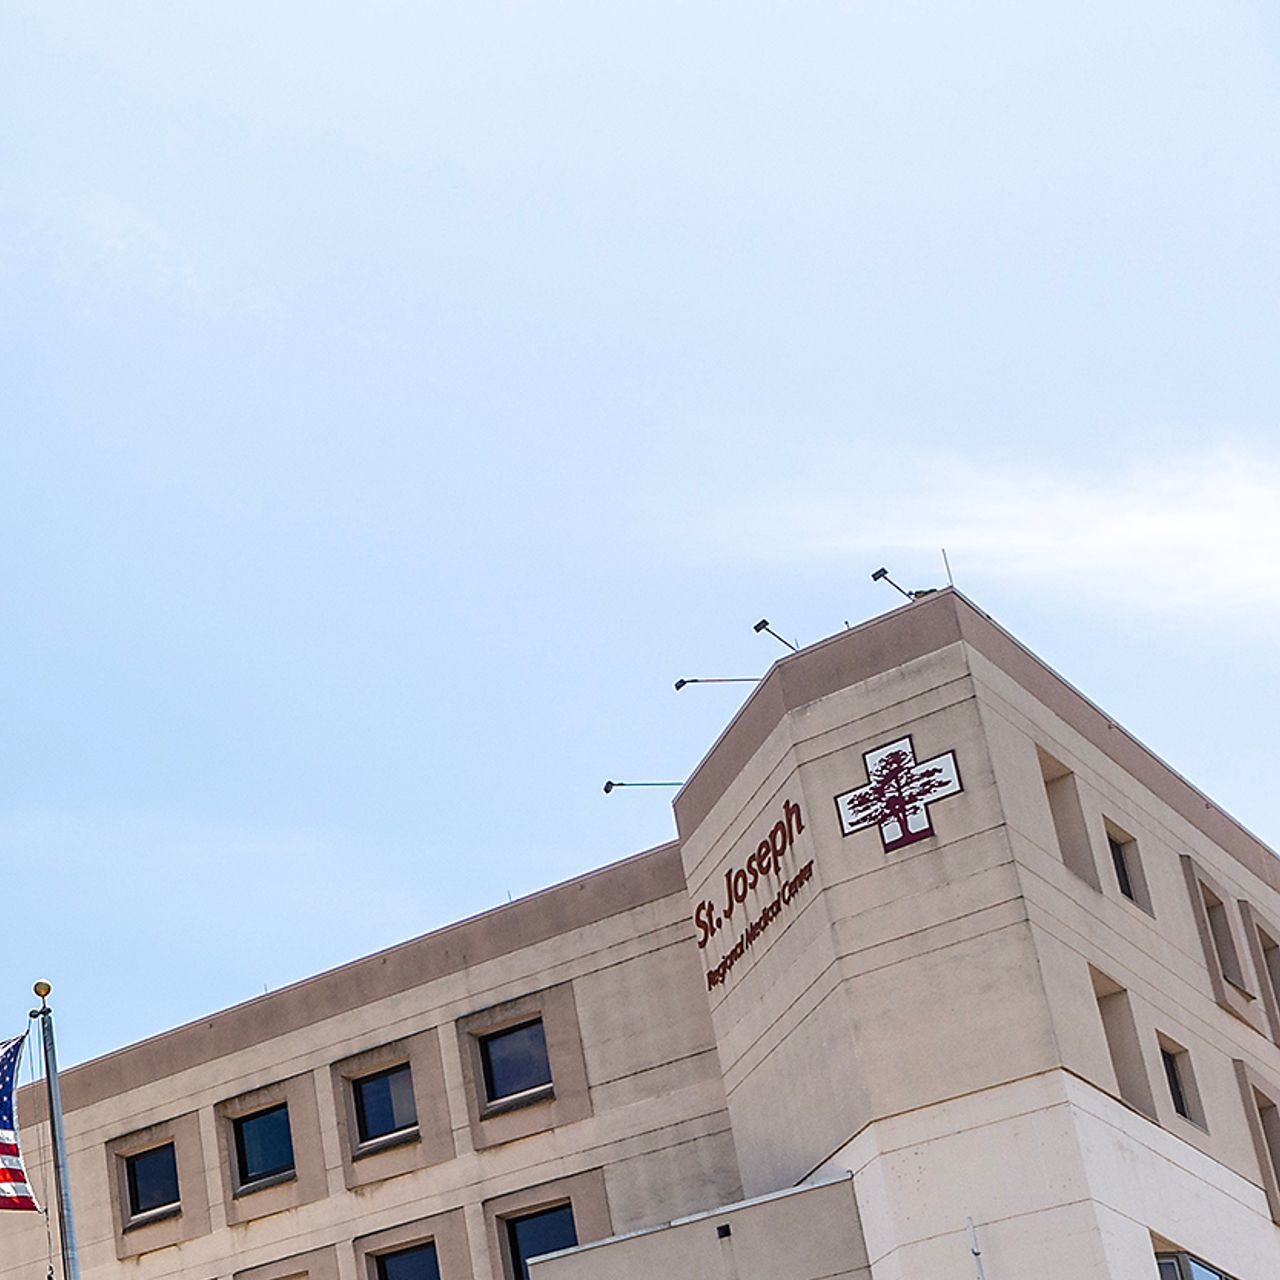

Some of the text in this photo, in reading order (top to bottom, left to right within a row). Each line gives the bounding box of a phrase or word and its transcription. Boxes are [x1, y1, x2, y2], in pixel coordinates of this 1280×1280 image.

[695, 799, 805, 949] St. Joseph
[706, 859, 814, 991] Regional Medical Center
